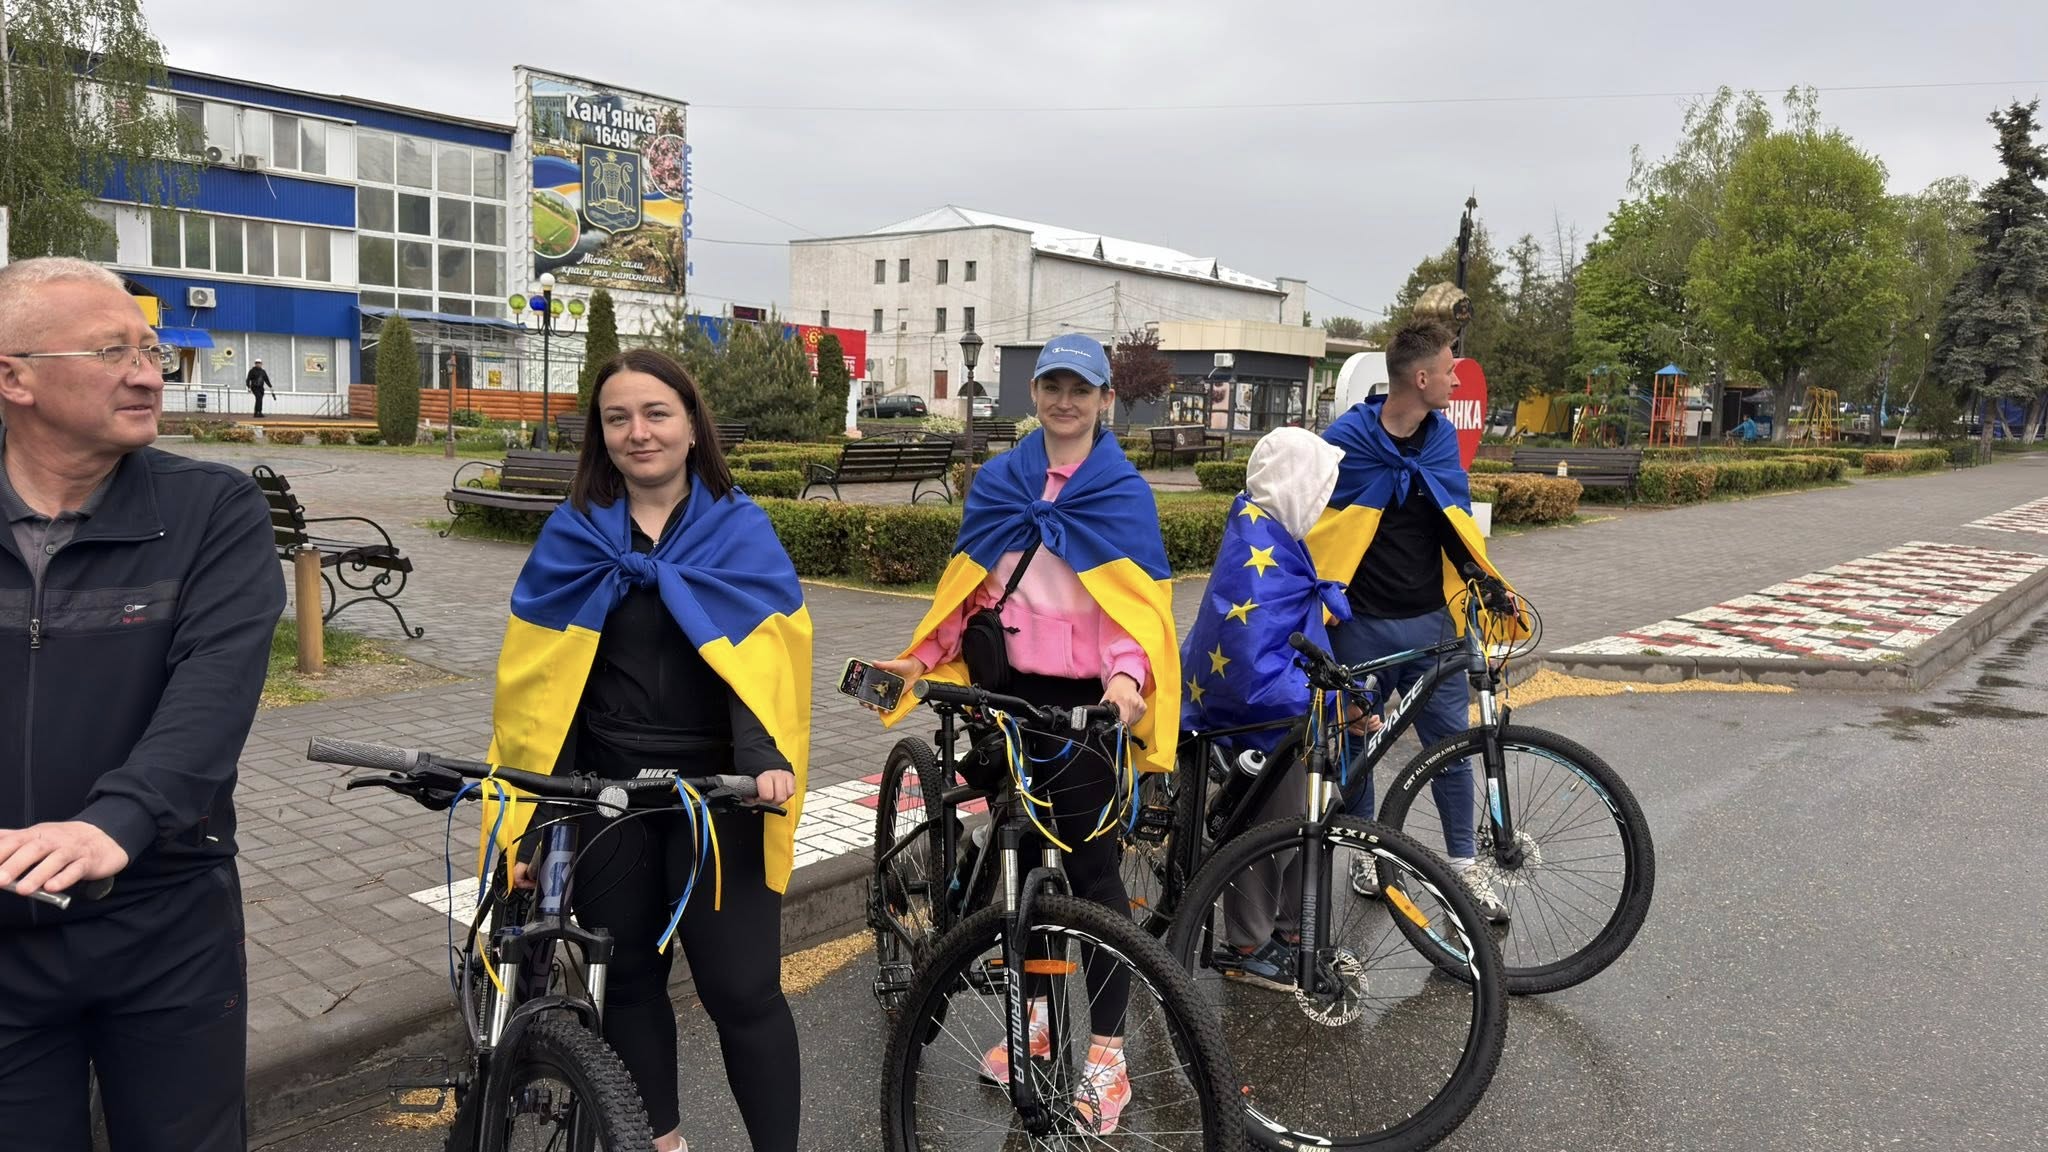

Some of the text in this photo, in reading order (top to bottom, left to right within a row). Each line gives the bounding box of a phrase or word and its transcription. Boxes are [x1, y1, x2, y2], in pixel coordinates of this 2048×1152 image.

[566, 93, 657, 135] Кам'янка
[594, 125, 631, 149] 1649
[682, 144, 693, 276] РЕСТОРН
[561, 265, 592, 277] краси
[593, 269, 610, 278] та
[576, 252, 613, 266] Місто
[1441, 399, 1483, 430] ЯНКА
[1367, 674, 1425, 758] SPACE
[636, 769, 679, 779] NIKE
[1298, 826, 1380, 844] XXIS
[1009, 967, 1025, 1085] FORMULA
